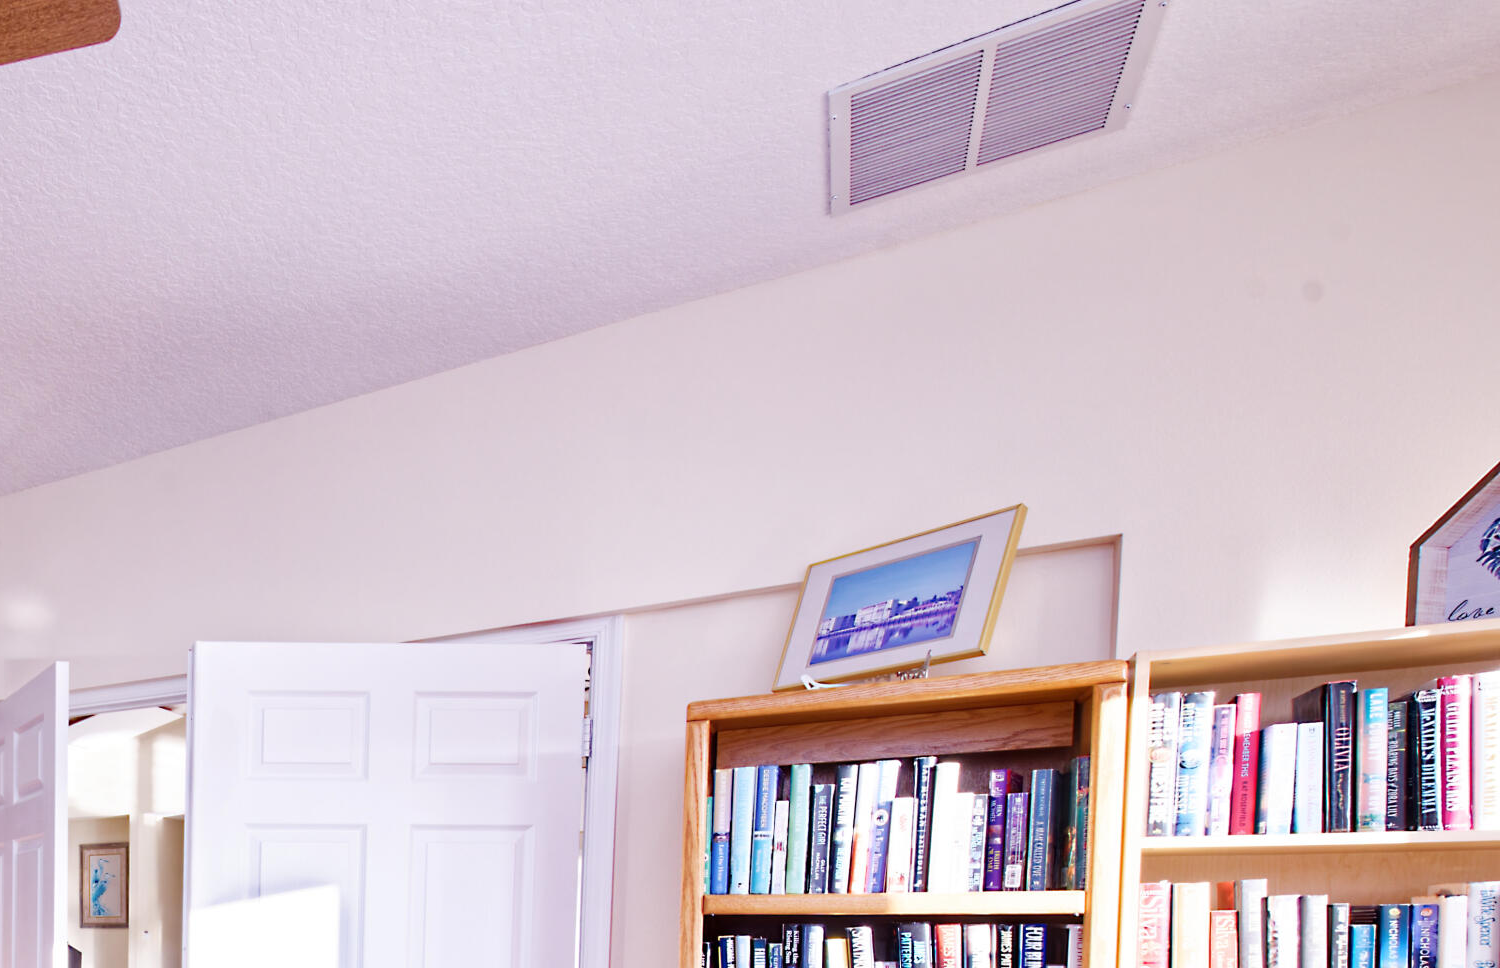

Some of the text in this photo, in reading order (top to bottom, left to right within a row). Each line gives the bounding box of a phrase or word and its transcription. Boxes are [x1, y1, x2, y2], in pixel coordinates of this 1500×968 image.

[1368, 693, 1383, 761] LAKE COUNTY
[1445, 702, 1461, 743] GUILTY
[1241, 731, 1251, 778] REMEMBER THIS
[1334, 727, 1351, 772] OLIVIA
[1421, 708, 1437, 814] McNALLY'S DILEMMA
[760, 769, 770, 828] DEBBIE MACOMBER
[1388, 740, 1398, 817] ROARING DAYS ZORA LILY
[1446, 747, 1461, 812] PLEASURES
[817, 796, 828, 845] THE PERFECT GIRL
[1239, 793, 1247, 827] ROSENFIELD
[1032, 827, 1044, 877] MAN CALLED OVE
[1025, 926, 1043, 950] FOUR
[1139, 896, 1165, 940] Silva
[1215, 916, 1236, 950] Silva
[1474, 916, 1496, 948] Spencer
[783, 930, 792, 950] Rising
[791, 930, 799, 952] Killing
[913, 941, 926, 963] JAMES
[943, 928, 956, 957] JAMES
[1001, 930, 1012, 952] JAMES
[1388, 920, 1401, 959] NICHOLAS
